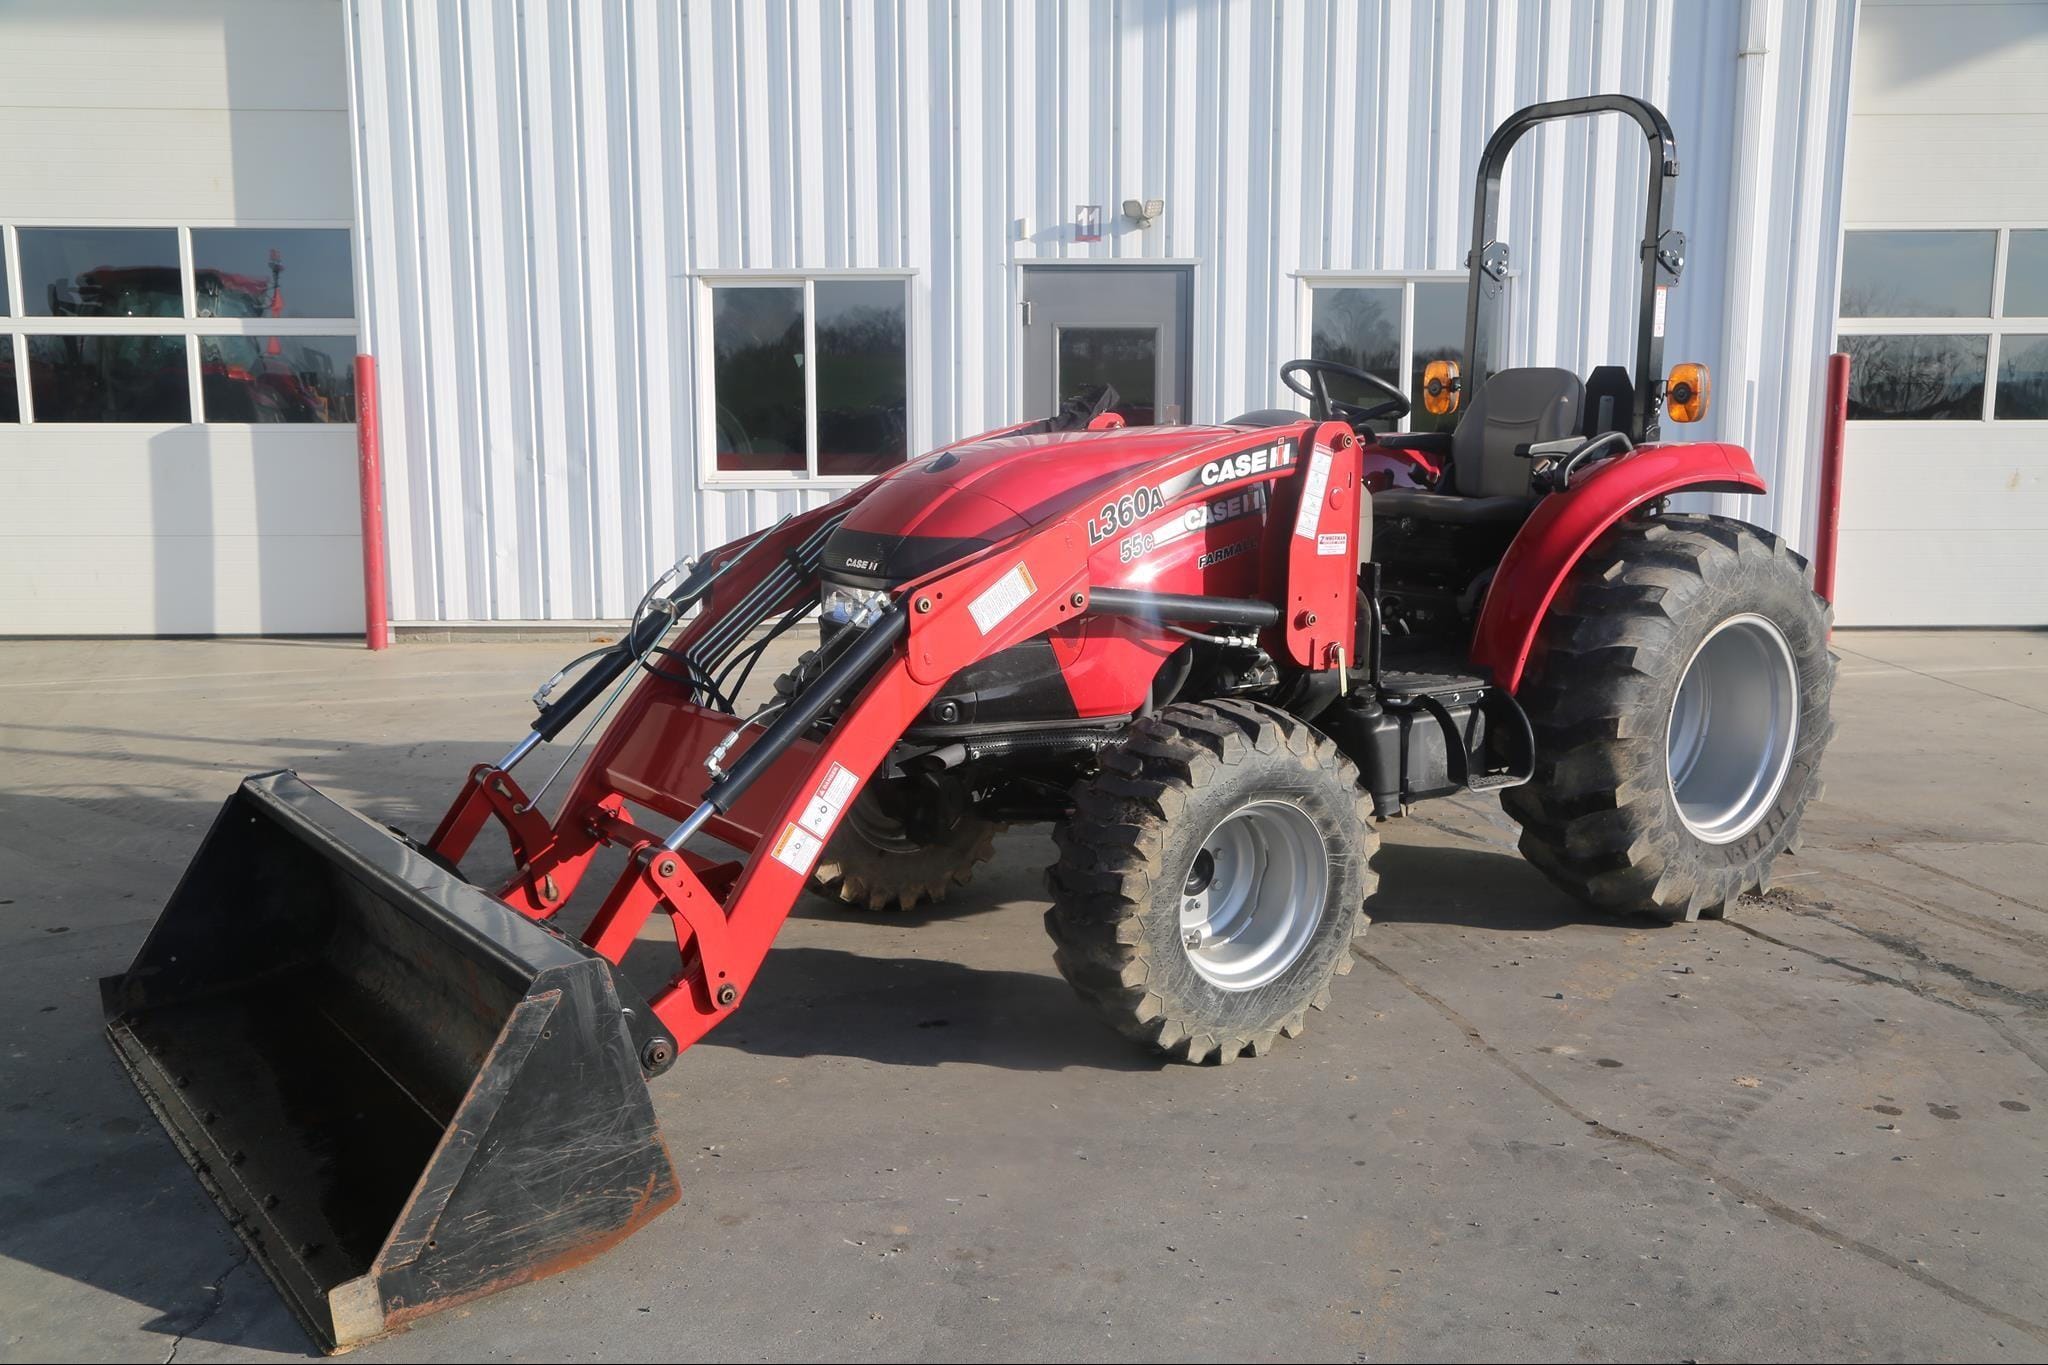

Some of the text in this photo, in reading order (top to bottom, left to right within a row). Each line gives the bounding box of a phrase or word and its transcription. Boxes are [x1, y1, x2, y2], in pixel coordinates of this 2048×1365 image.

[1077, 207, 1101, 236] 11
[1201, 448, 1267, 486] CASE
[1088, 485, 1165, 546] L360A
[1184, 496, 1241, 531] CASE
[846, 557, 868, 569] CASE
